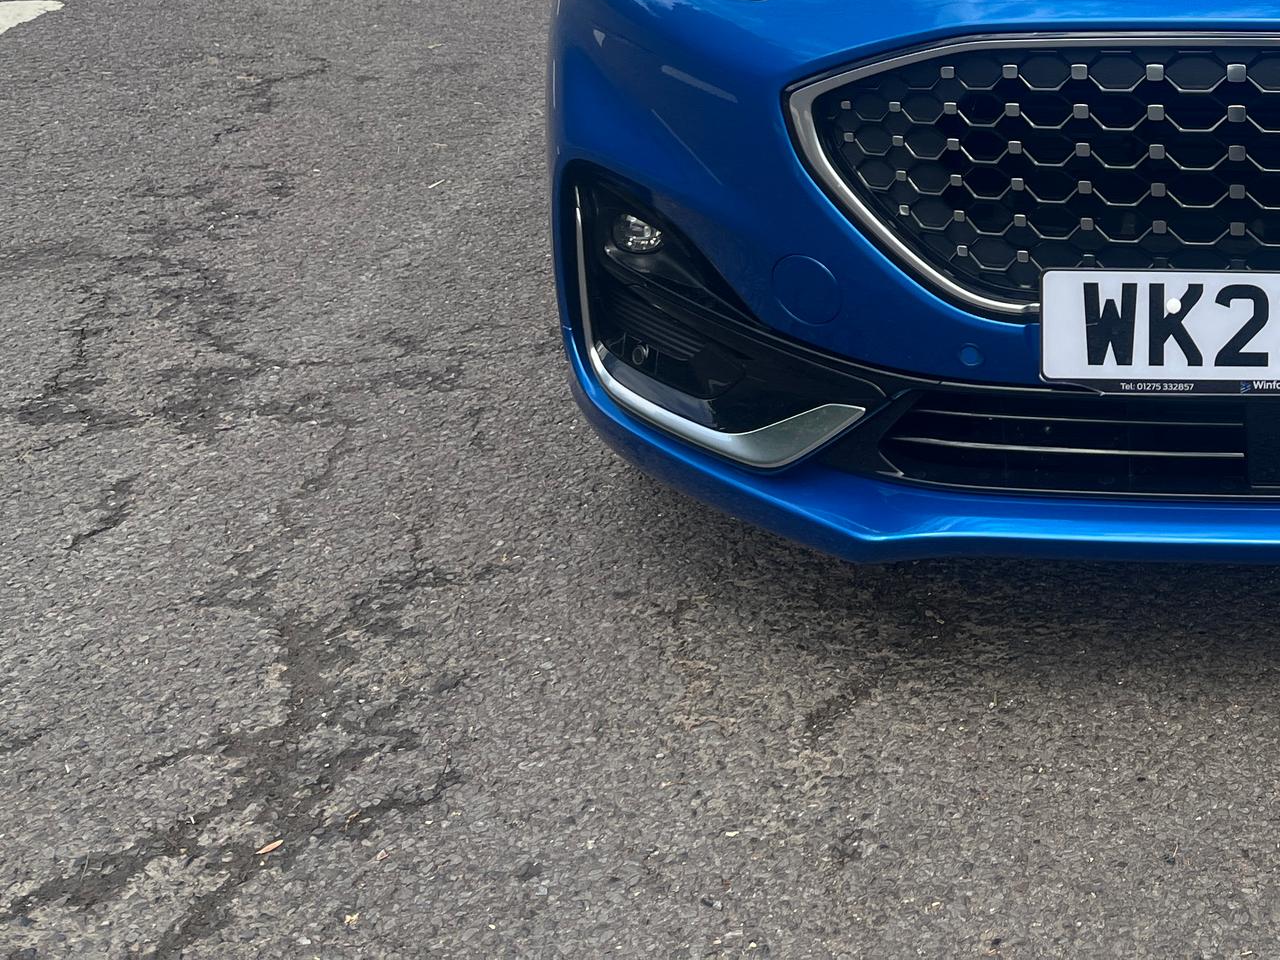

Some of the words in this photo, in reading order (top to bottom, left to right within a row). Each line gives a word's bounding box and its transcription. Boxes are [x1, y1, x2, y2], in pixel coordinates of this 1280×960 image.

[1120, 382, 1135, 390] Tel:
[1137, 382, 1161, 391] 01275
[1162, 383, 1194, 391] 332857
